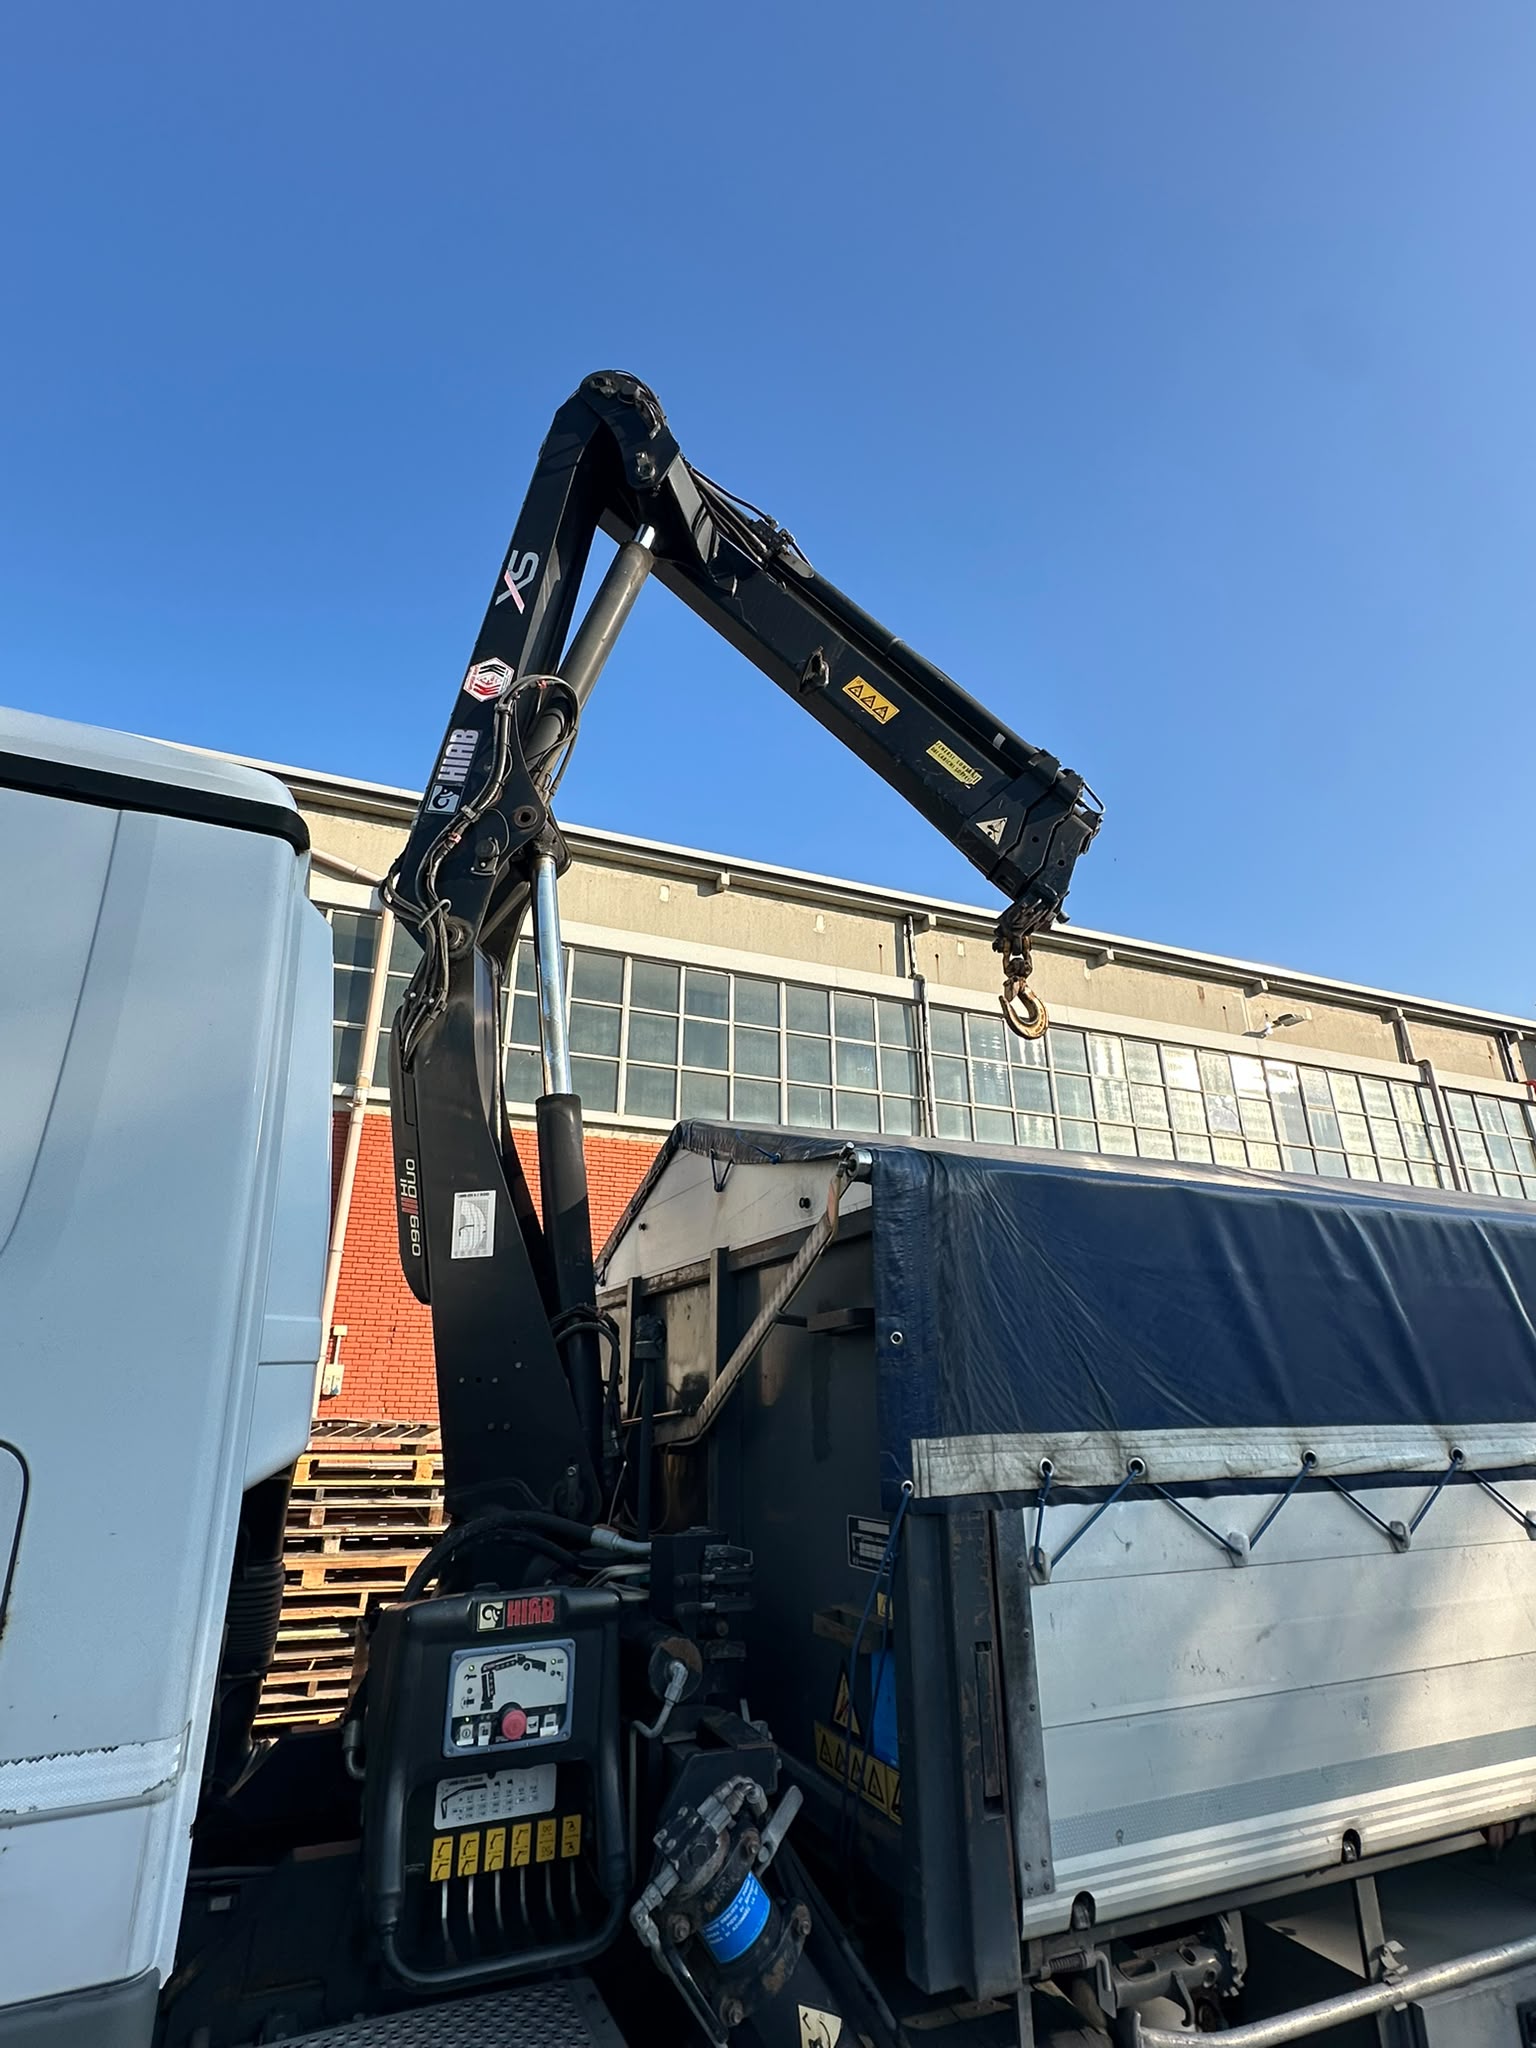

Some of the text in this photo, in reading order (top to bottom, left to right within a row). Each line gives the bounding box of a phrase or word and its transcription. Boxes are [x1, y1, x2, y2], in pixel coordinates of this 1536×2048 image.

[495, 549, 540, 615] XS
[437, 729, 480, 783] HIAB
[409, 1214, 422, 1257] 660
[506, 1596, 556, 1627] HIAB
